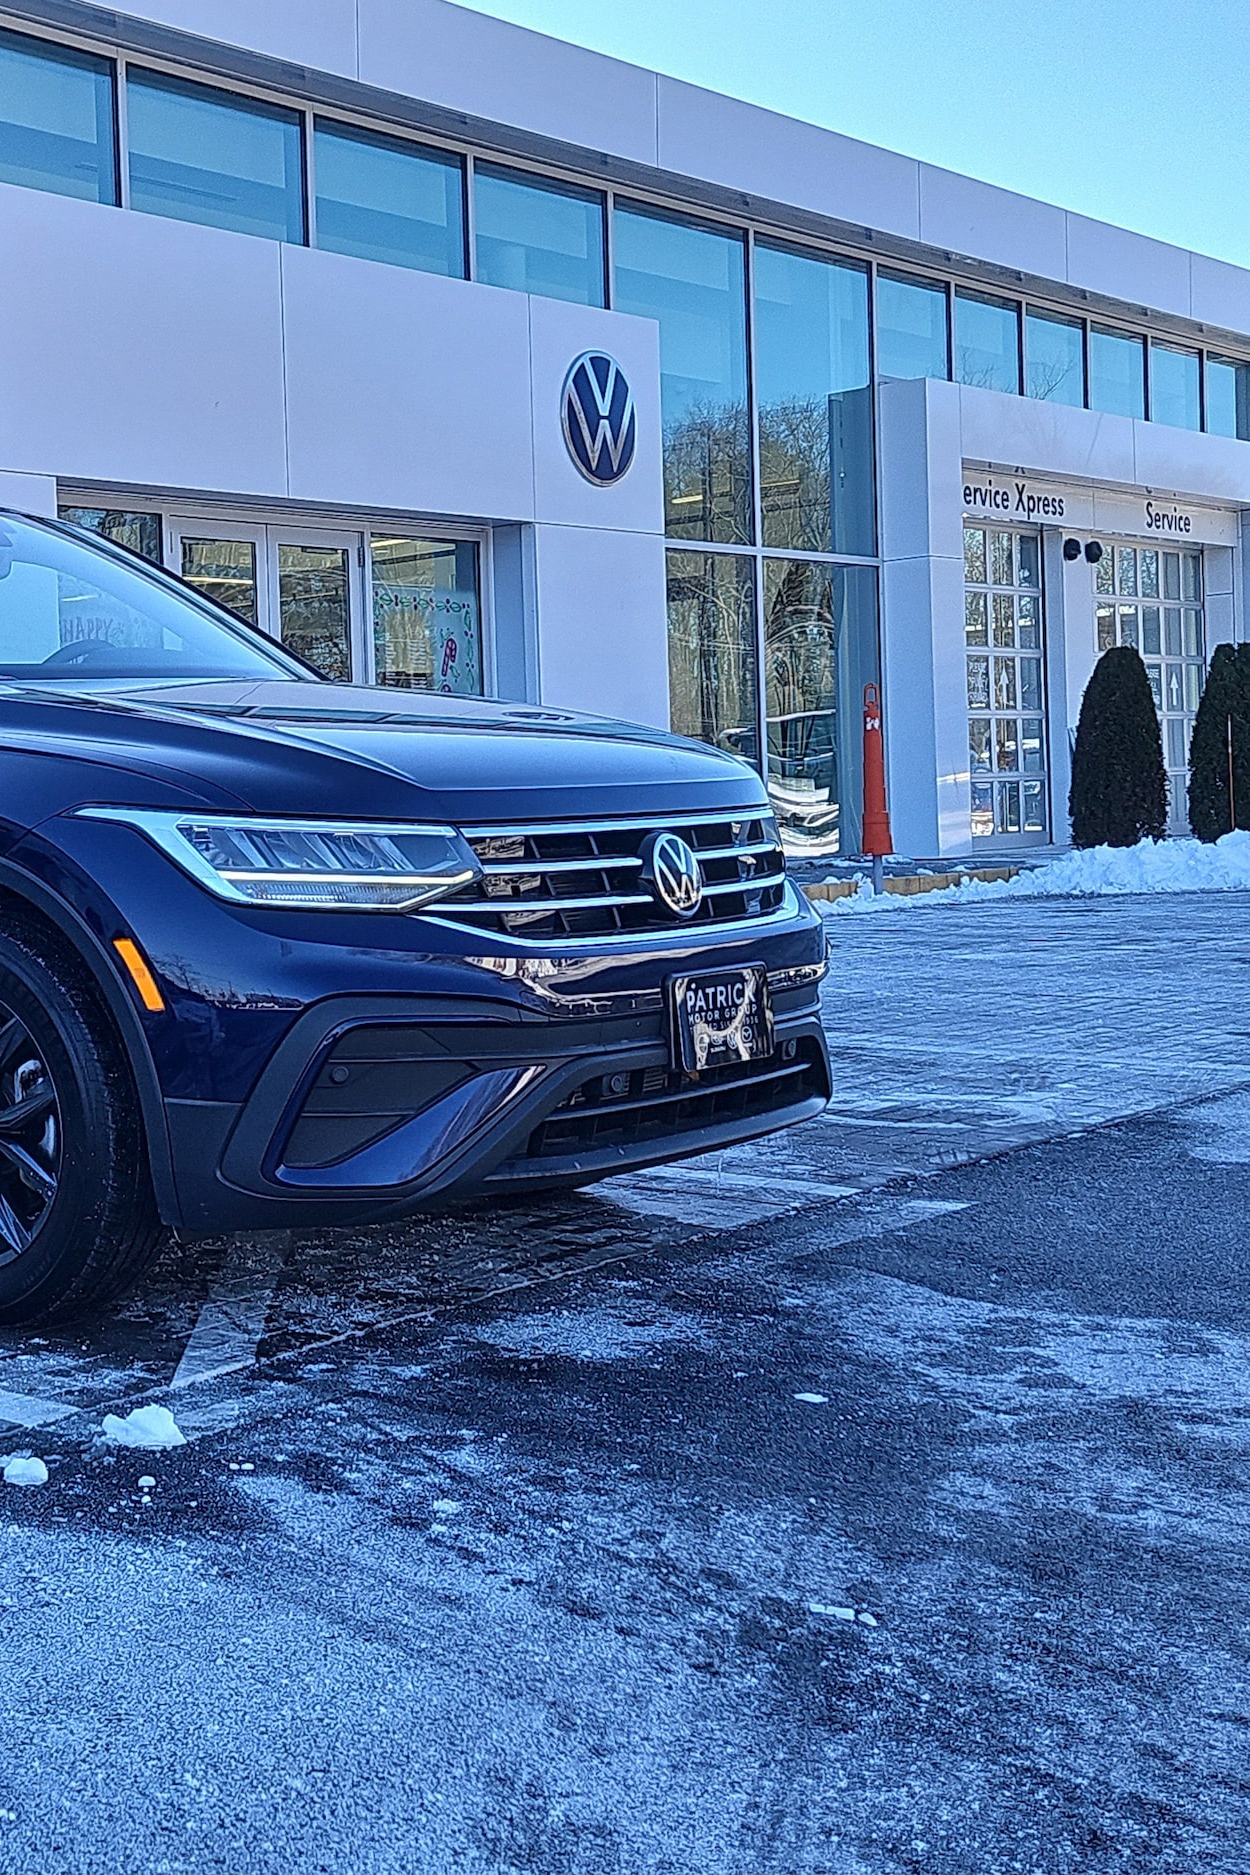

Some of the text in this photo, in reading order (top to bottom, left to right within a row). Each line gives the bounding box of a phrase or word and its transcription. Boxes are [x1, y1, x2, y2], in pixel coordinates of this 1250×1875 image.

[561, 350, 637, 487] VW
[963, 479, 1065, 519] ervice Xpress
[1146, 500, 1191, 534] Service
[653, 832, 701, 918] VW
[686, 982, 756, 1014] PATRICK
[688, 1010, 720, 1026] MOTOR
